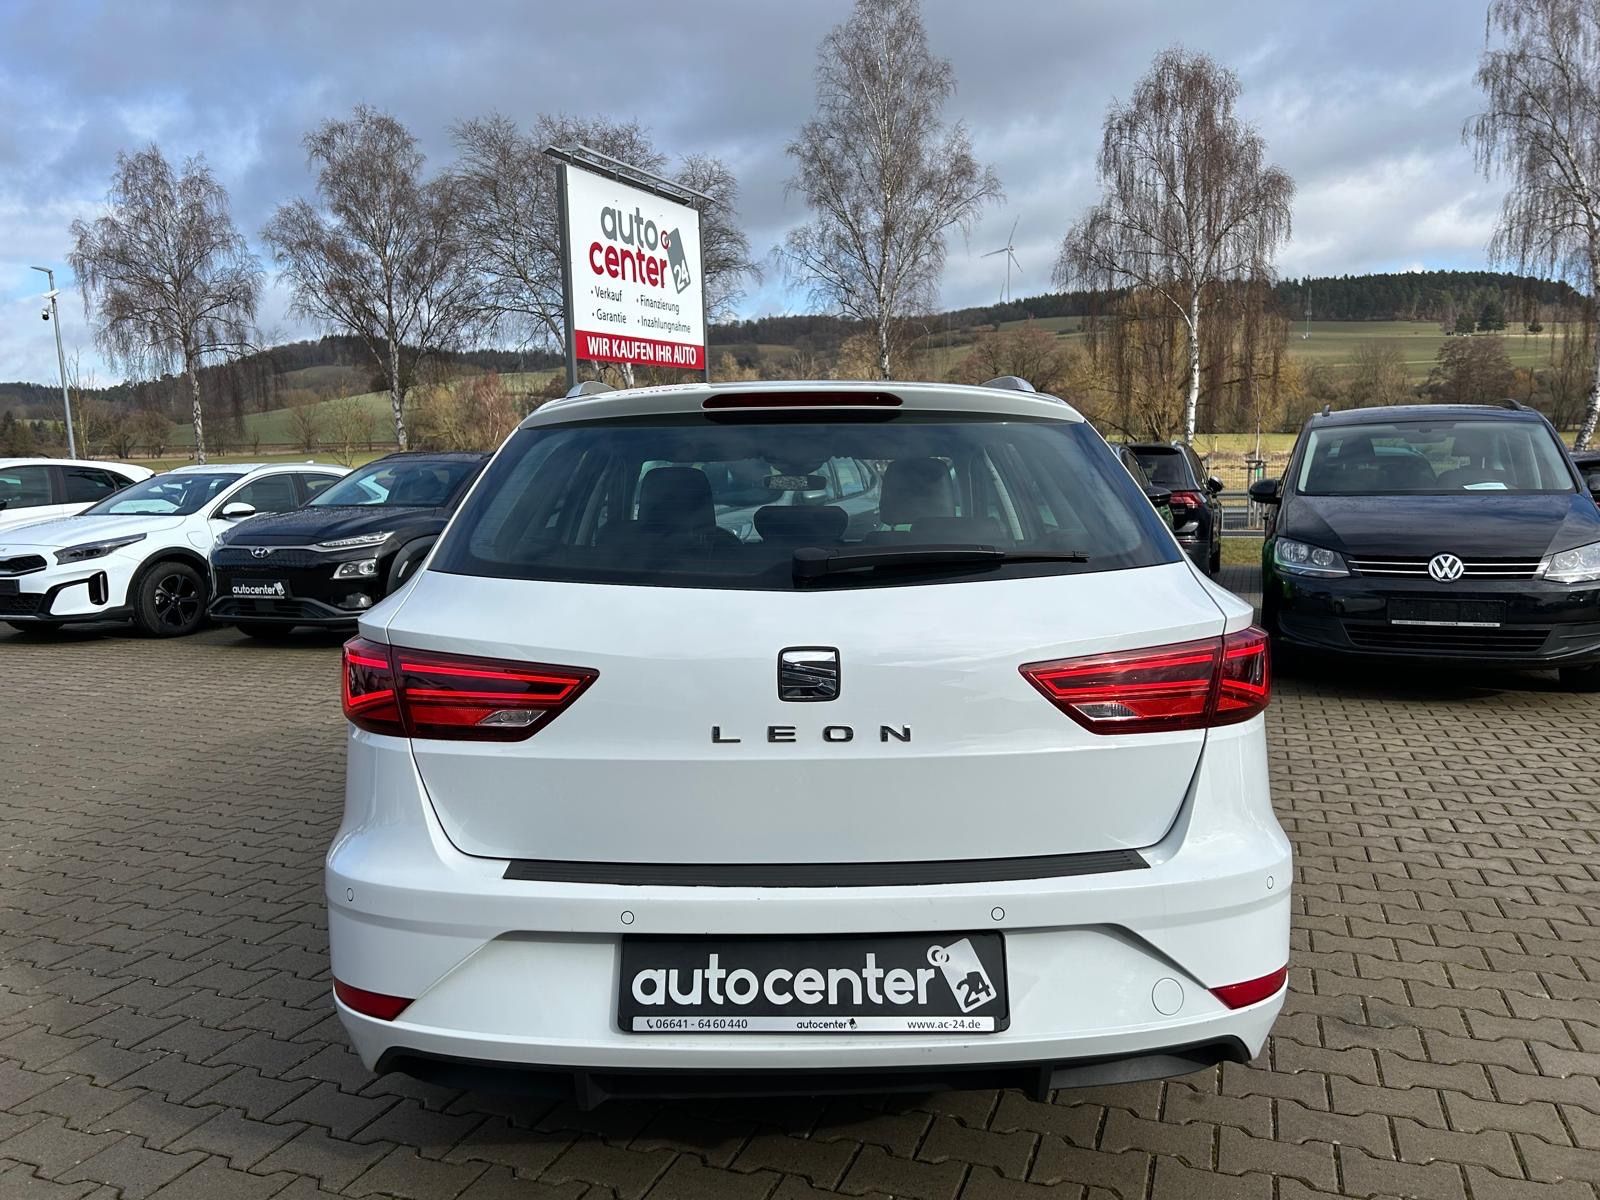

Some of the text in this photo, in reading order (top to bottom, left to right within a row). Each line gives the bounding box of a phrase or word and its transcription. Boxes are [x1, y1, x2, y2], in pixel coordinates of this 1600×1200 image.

[600, 206, 659, 251] auto
[589, 241, 668, 289] center
[594, 286, 623, 303] Verkauf
[640, 294, 680, 316] Finanzierung
[596, 308, 627, 324] Garantie
[641, 315, 691, 334] Inzahlungnahme
[587, 336, 697, 365] WIR KAUFEN IHR AUTO
[711, 725, 912, 743] LEON
[956, 971, 992, 1009] 24
[655, 1018, 688, 1029] 06641
[796, 1018, 847, 1029] autocenter
[907, 1018, 981, 1029] www.ac-24.de
